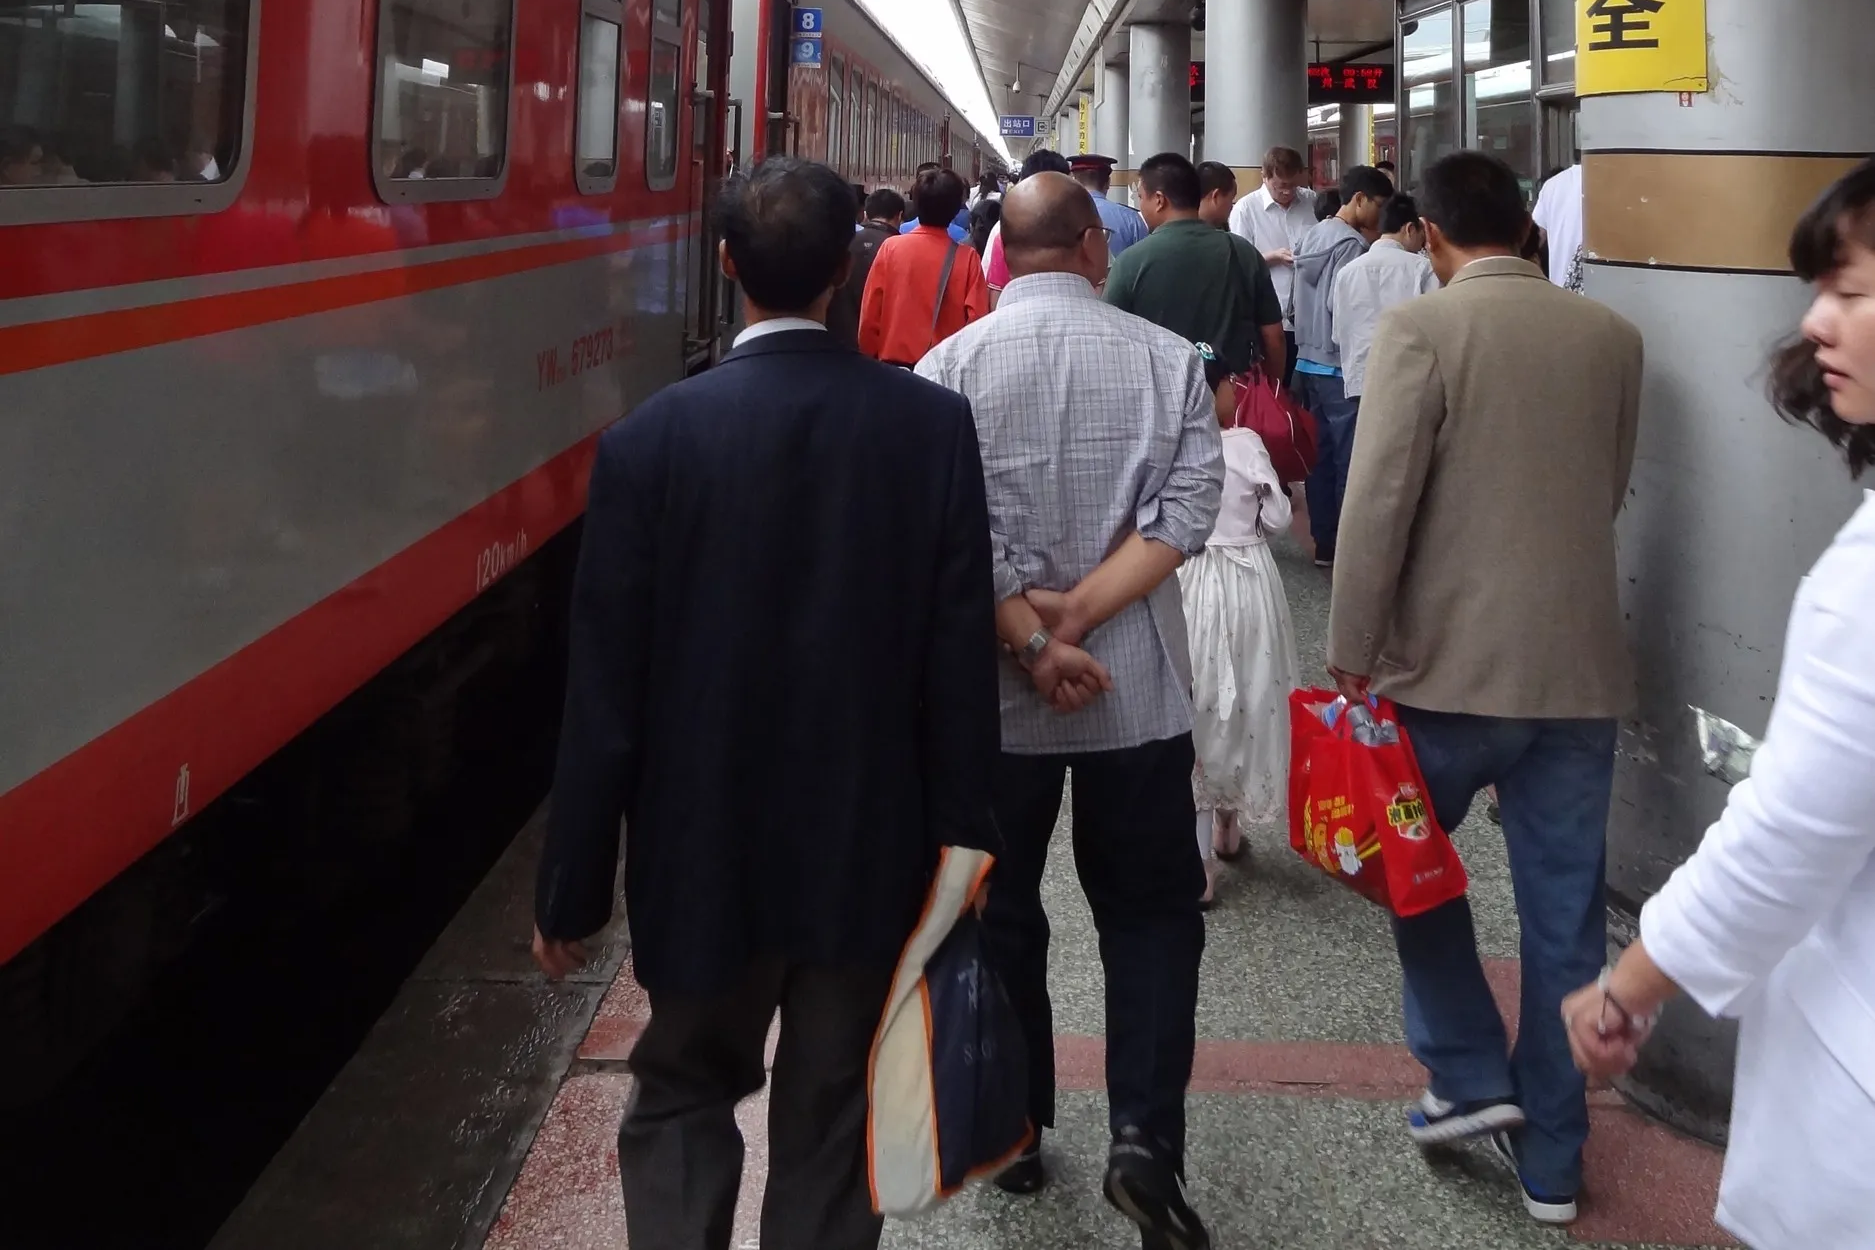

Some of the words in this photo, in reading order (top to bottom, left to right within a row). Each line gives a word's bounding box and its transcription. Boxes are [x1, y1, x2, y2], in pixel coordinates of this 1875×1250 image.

[802, 12, 815, 30] 8
[801, 41, 814, 58] 9
[1003, 118, 1030, 128] 出站口
[476, 527, 528, 593] 120km/h
